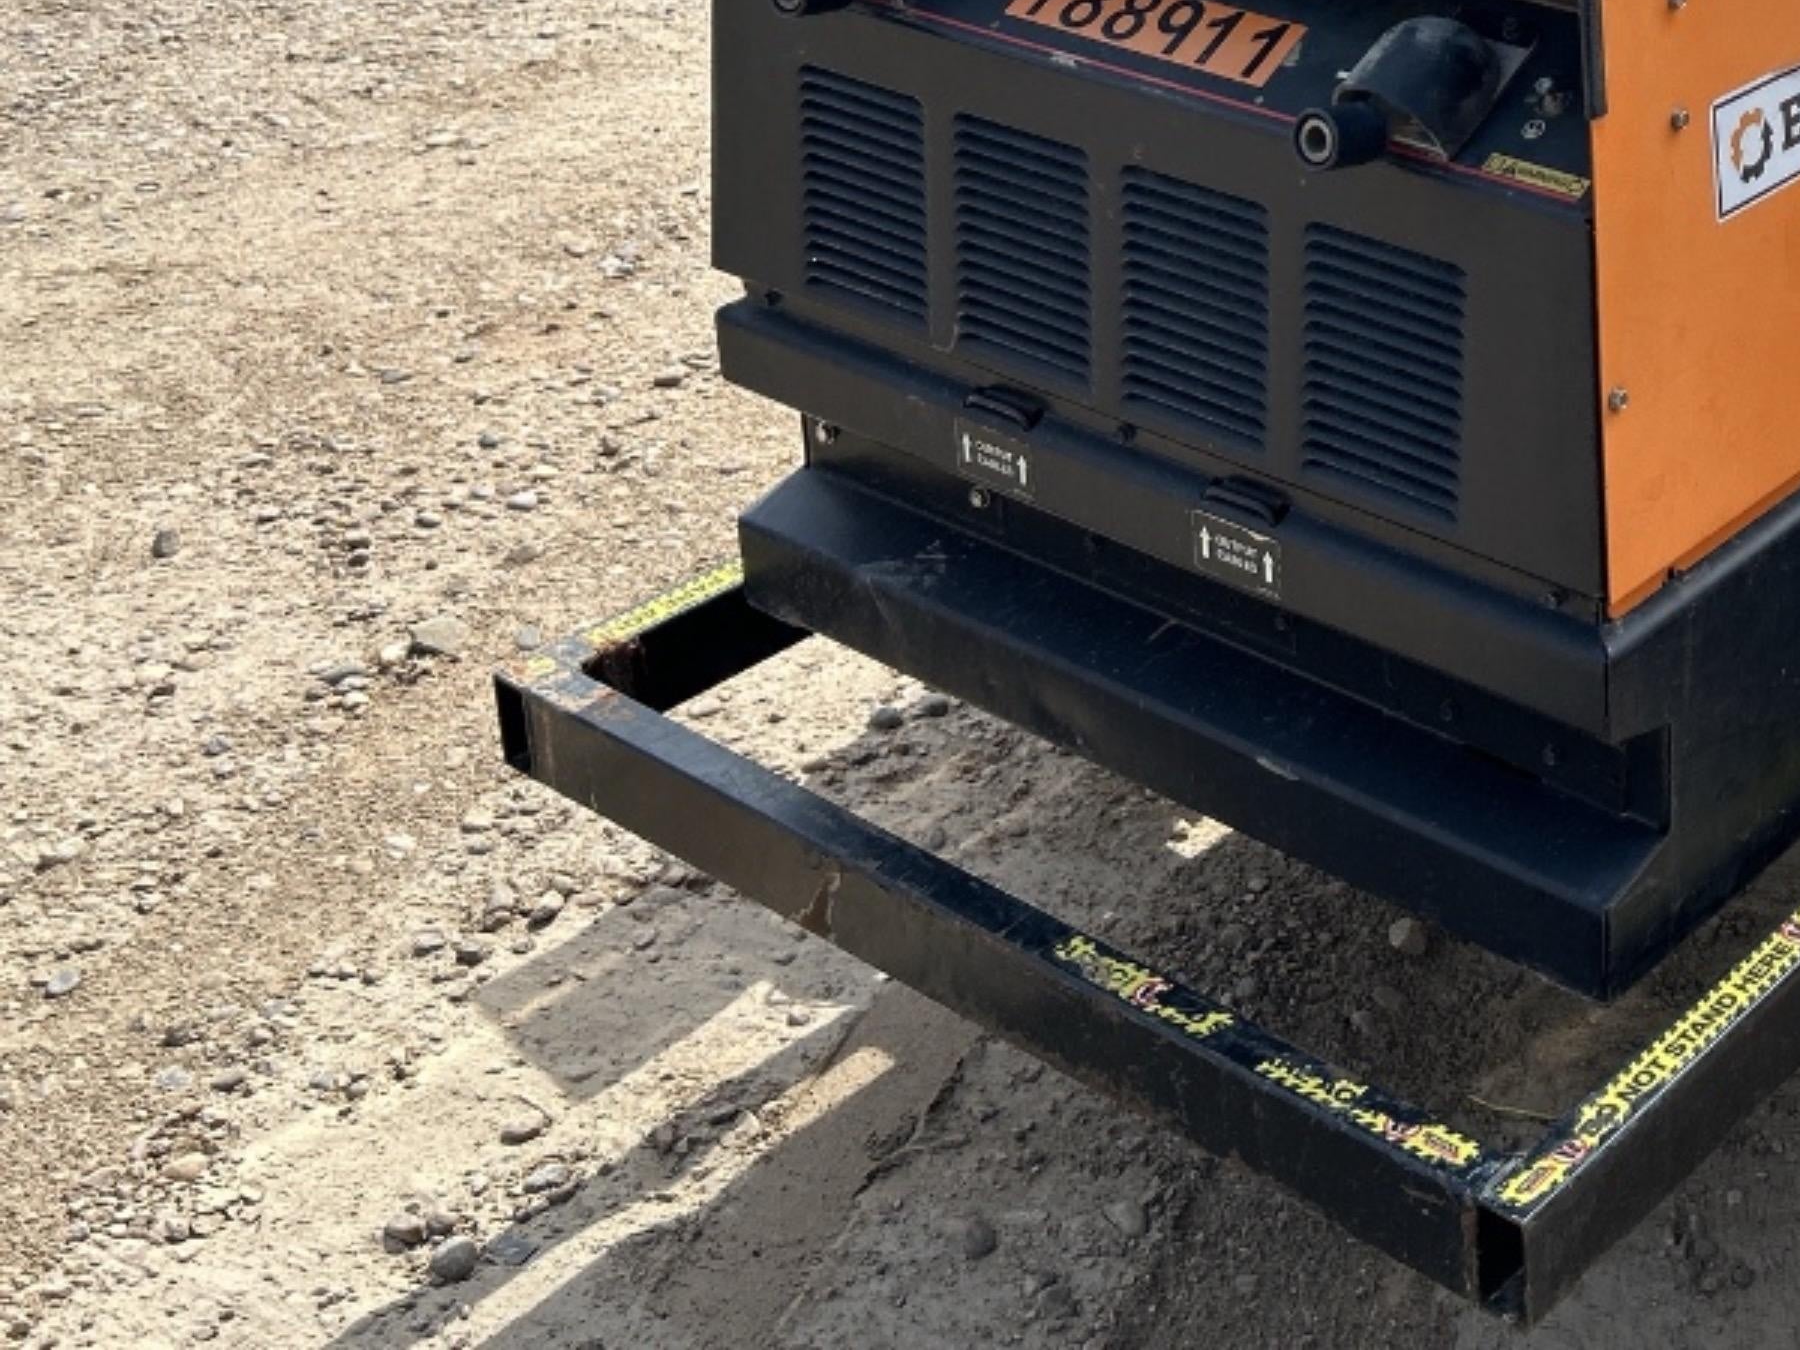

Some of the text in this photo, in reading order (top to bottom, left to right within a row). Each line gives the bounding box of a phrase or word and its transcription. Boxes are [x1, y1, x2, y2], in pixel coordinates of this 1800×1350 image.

[1614, 1059, 1668, 1105] NOT
[1664, 991, 1738, 1058] STAND
[1736, 940, 1794, 994] HERE
